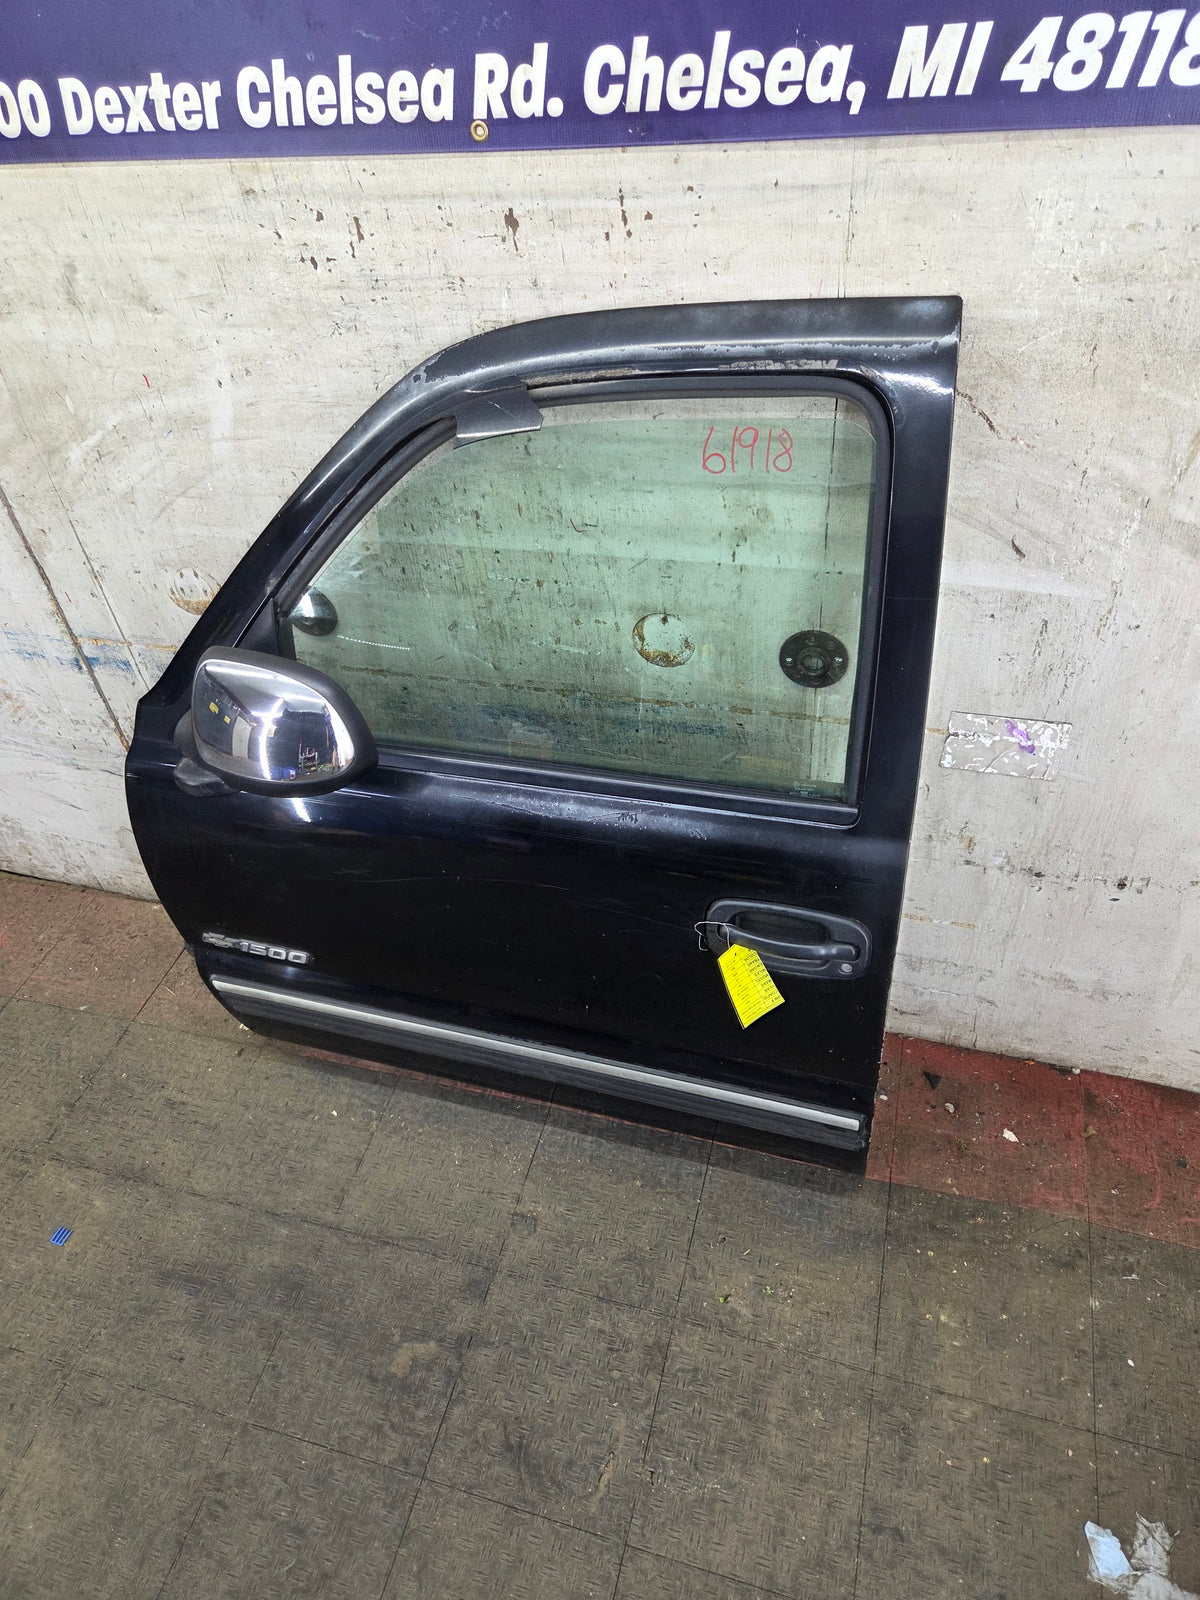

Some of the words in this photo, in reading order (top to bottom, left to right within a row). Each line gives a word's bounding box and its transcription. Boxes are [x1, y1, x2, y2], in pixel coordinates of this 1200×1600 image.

[58, 72, 221, 135] Dexter
[236, 54, 454, 128] Chelsea
[473, 42, 563, 120] Rd.
[583, 30, 866, 115] Chelsea,
[887, 21, 994, 99] MI
[702, 426, 793, 474] 61918
[239, 940, 309, 964] 1500
